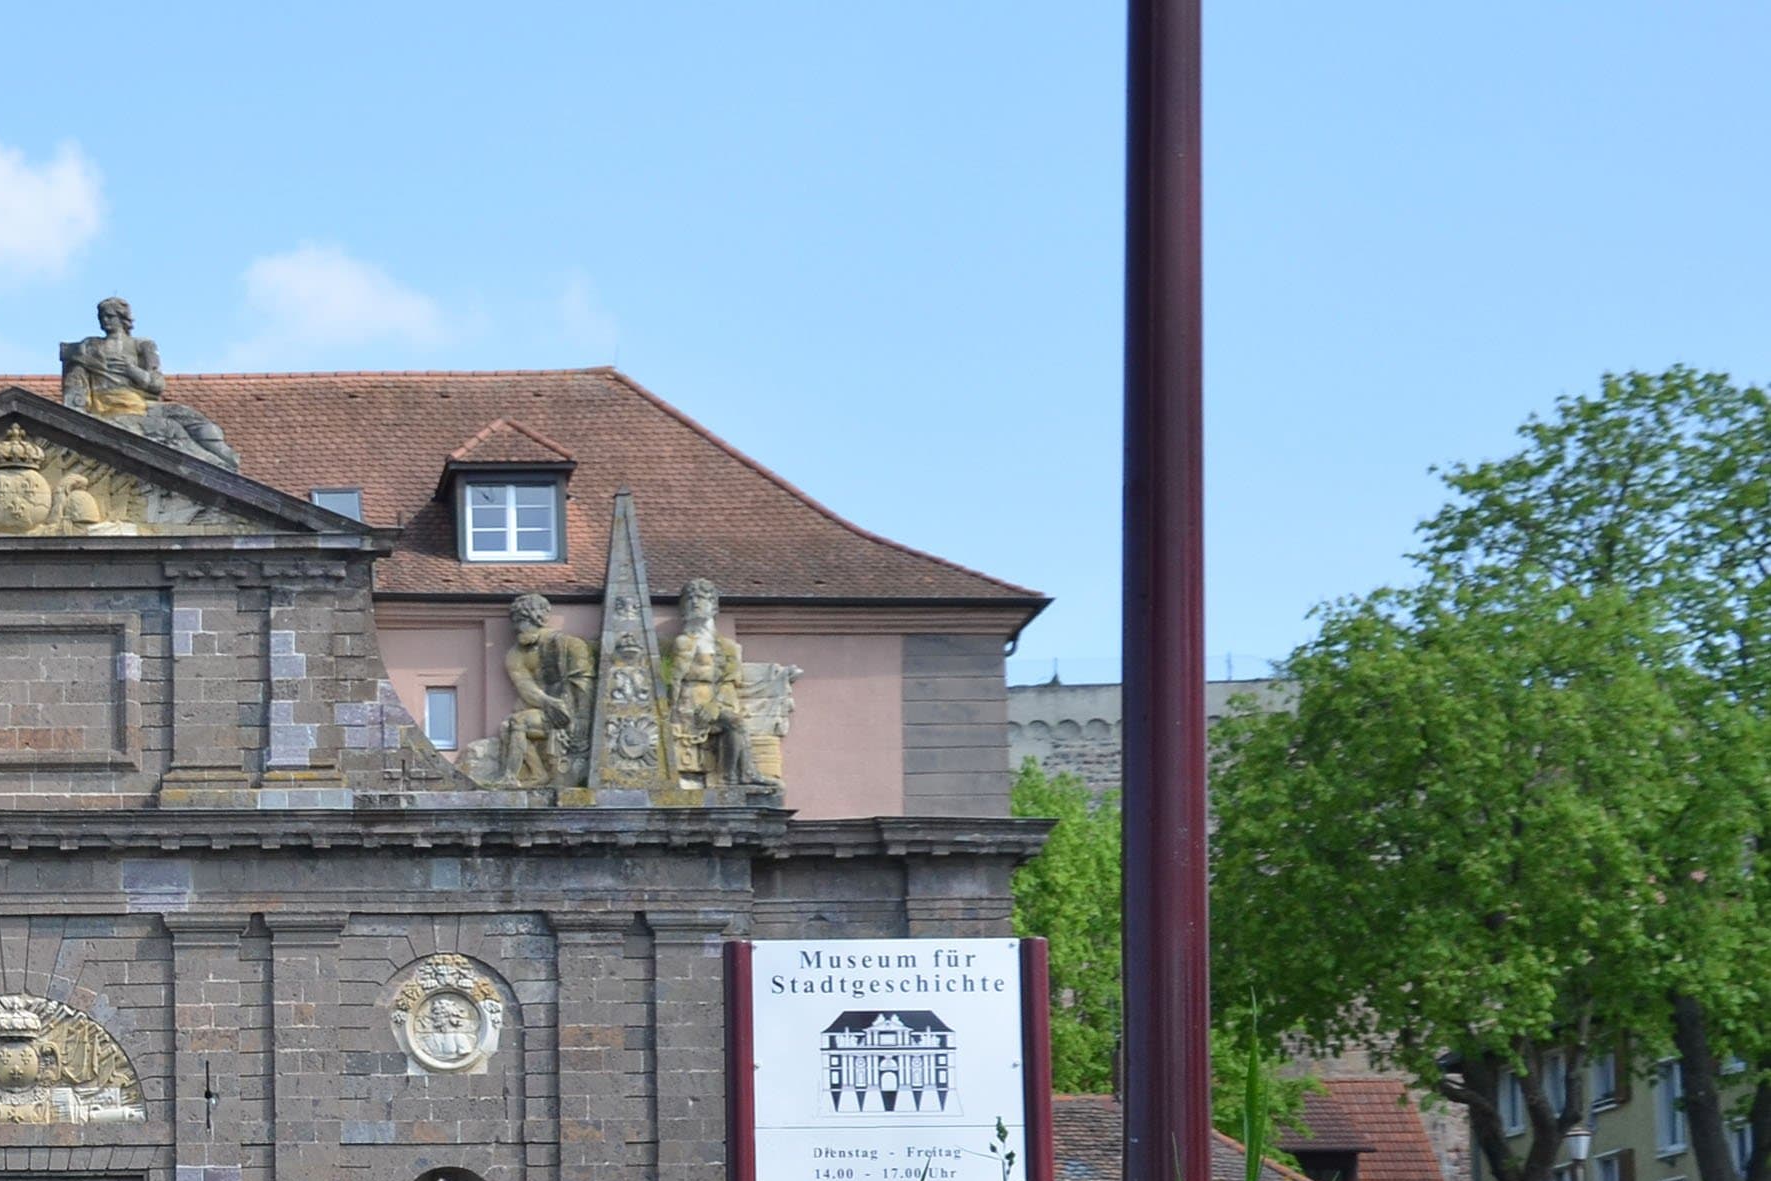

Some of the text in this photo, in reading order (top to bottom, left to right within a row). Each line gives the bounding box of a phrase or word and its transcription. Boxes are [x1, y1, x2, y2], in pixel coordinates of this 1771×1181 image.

[799, 949, 977, 969] Museum für
[771, 974, 1005, 998] Stadtgeschichte
[813, 1147, 878, 1160] Dienstag
[907, 1146, 962, 1159] Freitag
[815, 1169, 854, 1179] 14.00
[883, 1168, 922, 1179] 17.00
[929, 1168, 957, 1178] Uhr
